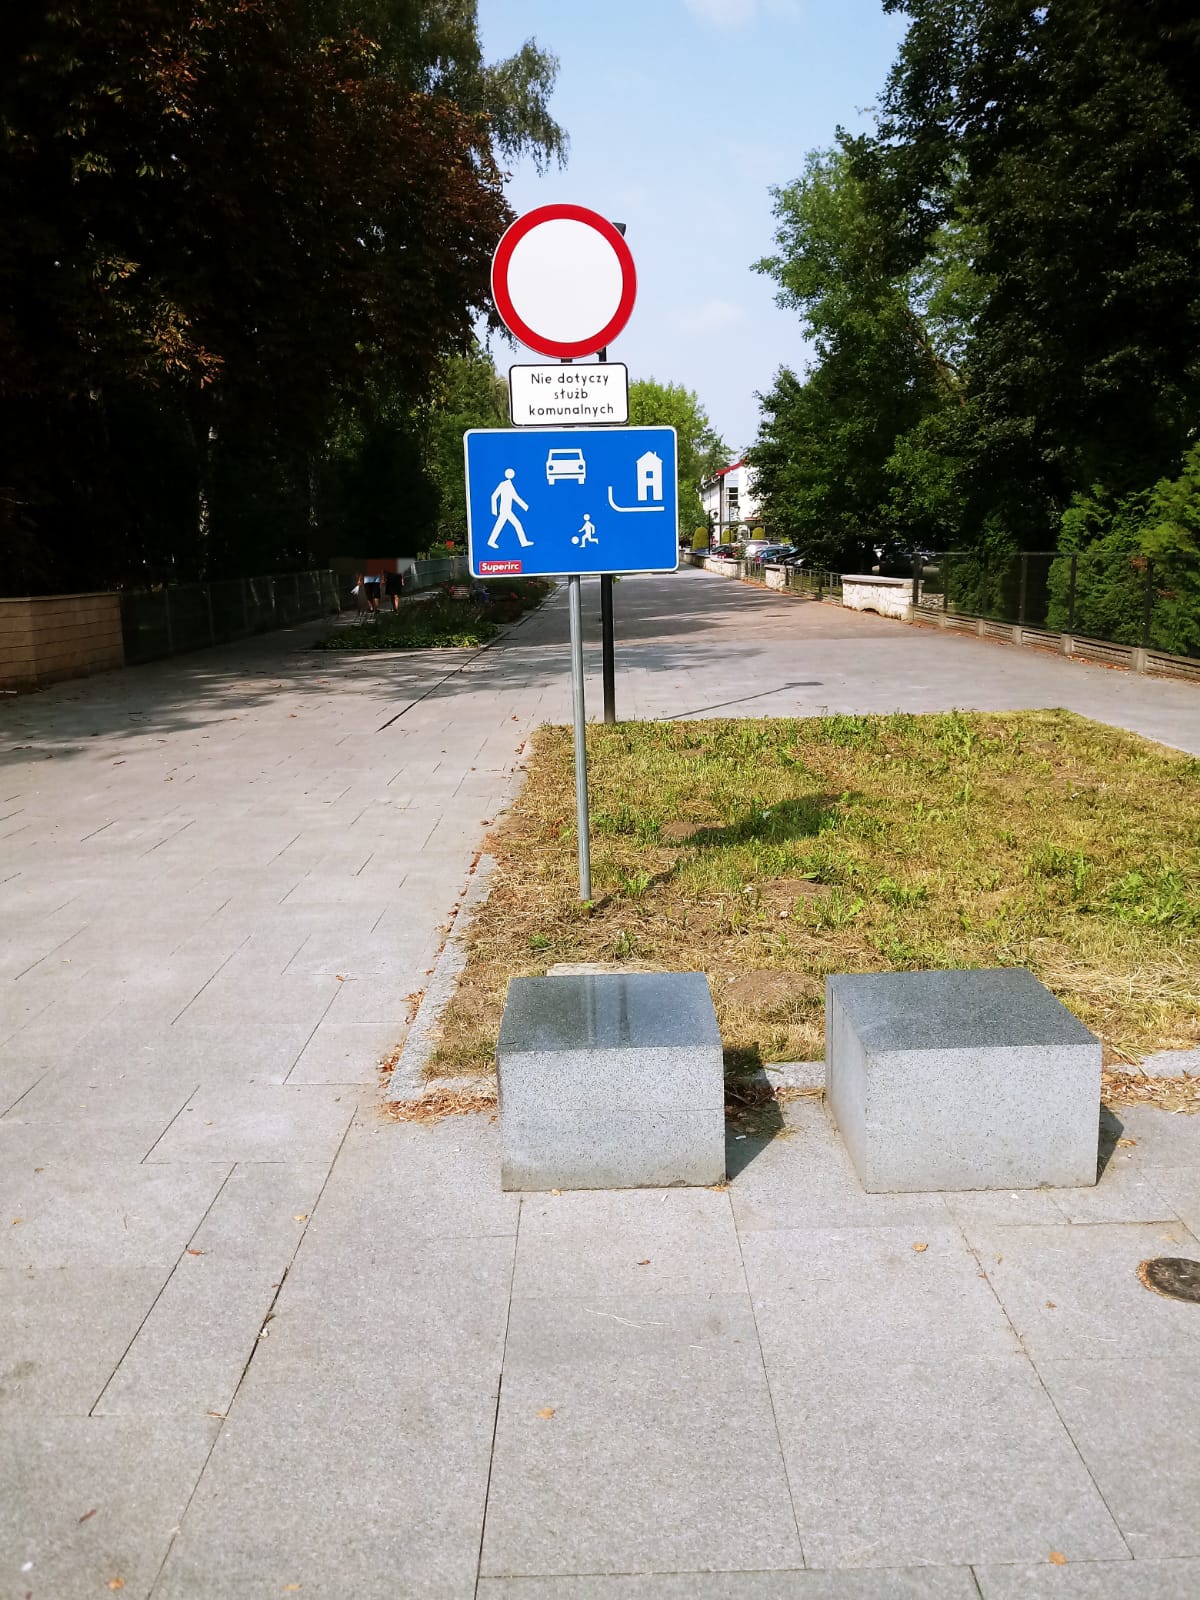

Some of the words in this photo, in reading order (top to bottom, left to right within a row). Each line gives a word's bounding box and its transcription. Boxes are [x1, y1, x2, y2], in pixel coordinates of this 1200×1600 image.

[531, 373, 552, 384] Nie
[557, 372, 609, 386] dotyczy
[554, 388, 588, 400] służb
[529, 403, 614, 418] komunalnych
[481, 562, 520, 573] Superirc
